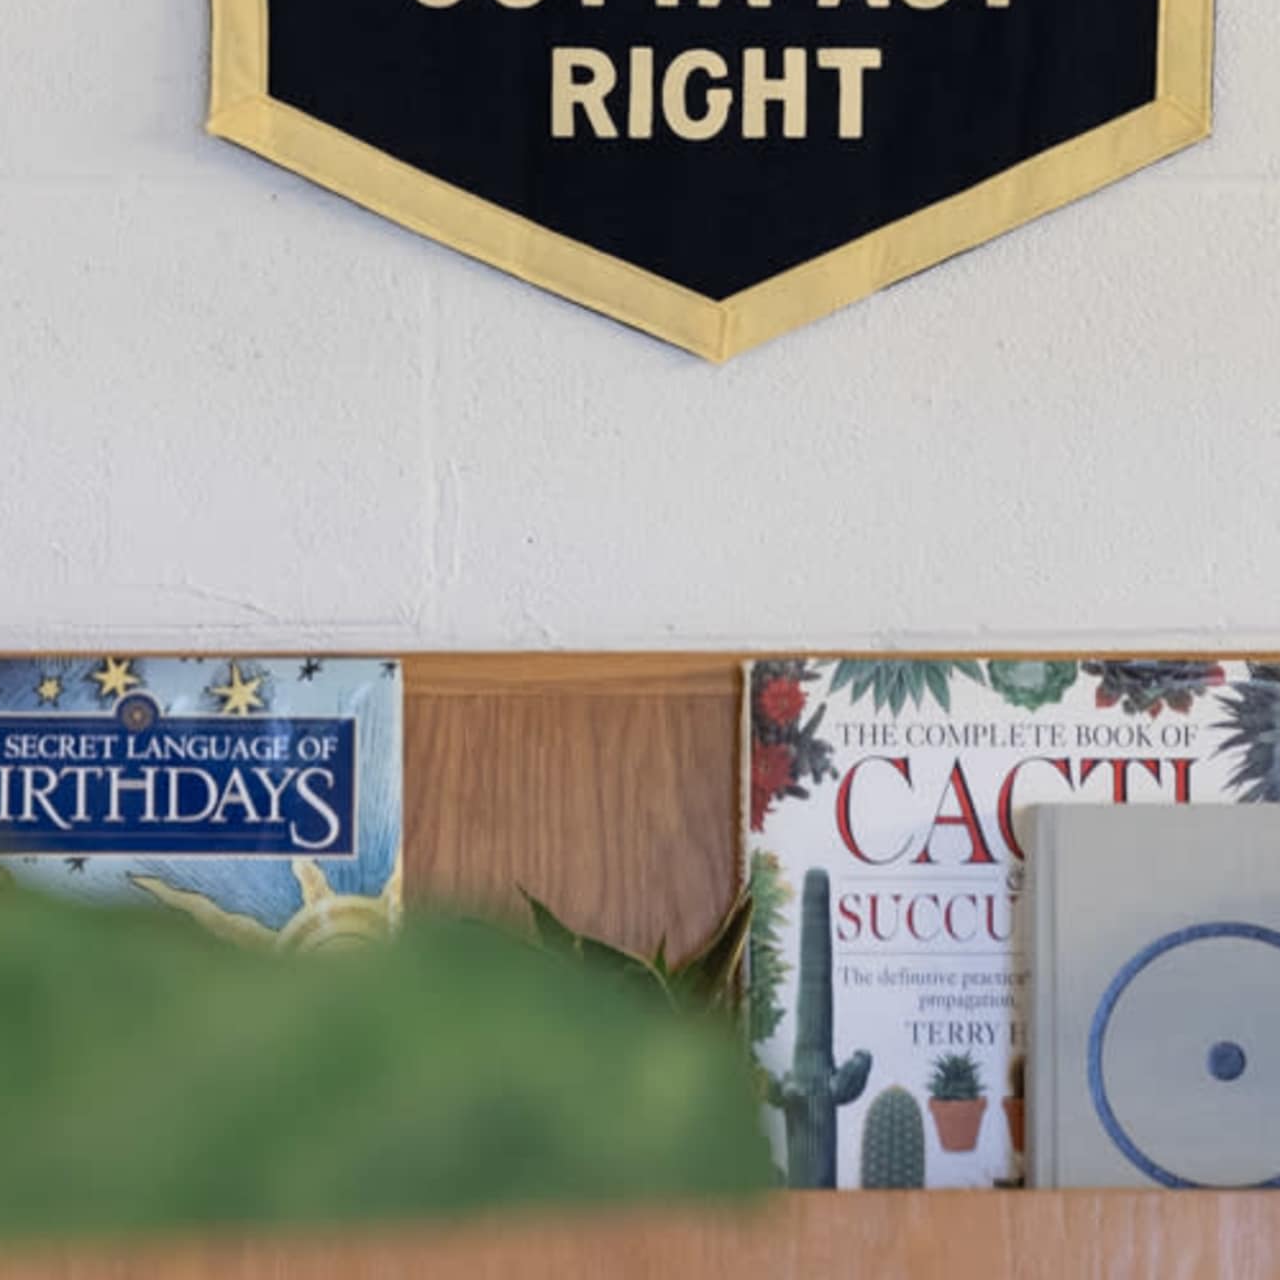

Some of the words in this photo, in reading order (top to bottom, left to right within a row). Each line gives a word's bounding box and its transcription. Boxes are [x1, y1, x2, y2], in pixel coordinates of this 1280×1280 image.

[552, 47, 882, 140] RIGHT
[4, 734, 119, 760] SECRET
[125, 733, 290, 762] LANGUAGE
[296, 736, 339, 761] OF
[835, 723, 897, 748] THE
[905, 723, 1067, 748] COMPLETE
[1075, 723, 1155, 747] BOOK
[1161, 723, 1200, 747] OF
[837, 965, 872, 986] The
[877, 966, 956, 986] definitive
[903, 1020, 1000, 1045] TERRY
